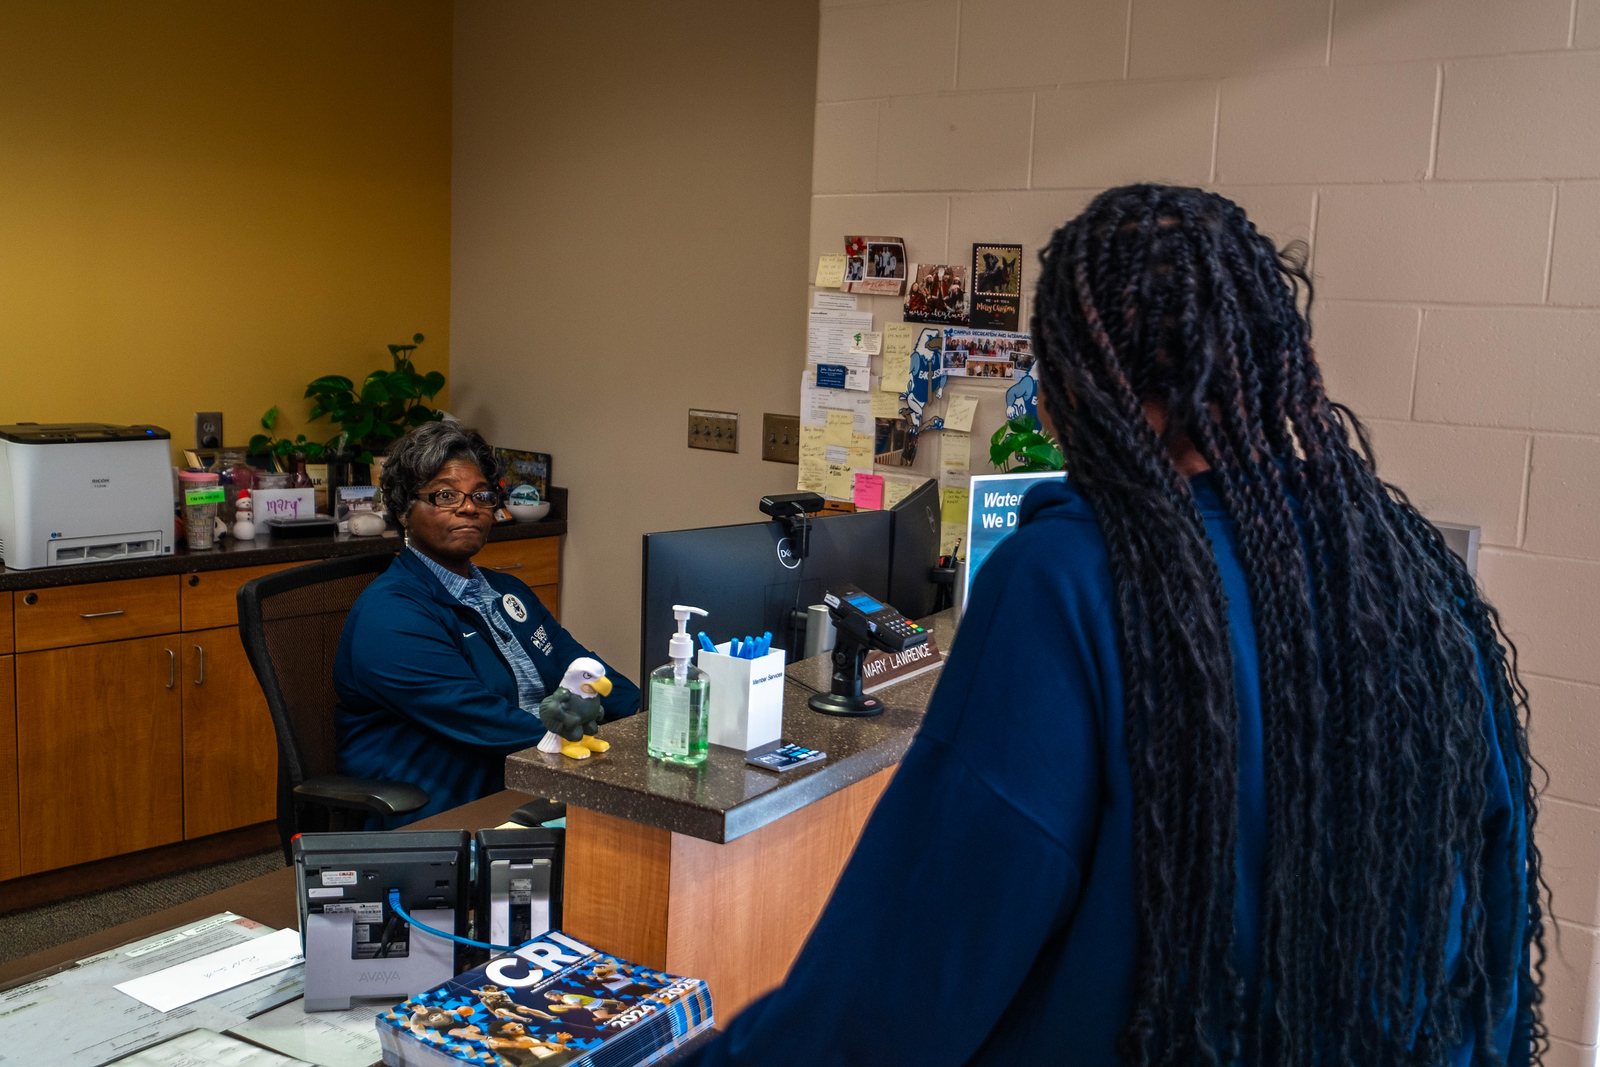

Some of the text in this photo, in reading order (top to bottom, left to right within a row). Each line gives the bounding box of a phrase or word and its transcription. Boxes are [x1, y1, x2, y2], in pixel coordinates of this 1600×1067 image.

[982, 513, 1004, 529] We
[863, 643, 932, 678] MARY LAWRENCE
[752, 672, 783, 685] Member Services
[486, 931, 596, 988] CRI
[358, 971, 401, 984] AVAYA
[610, 1004, 657, 1029] 2024
[660, 978, 700, 1000] 2025
